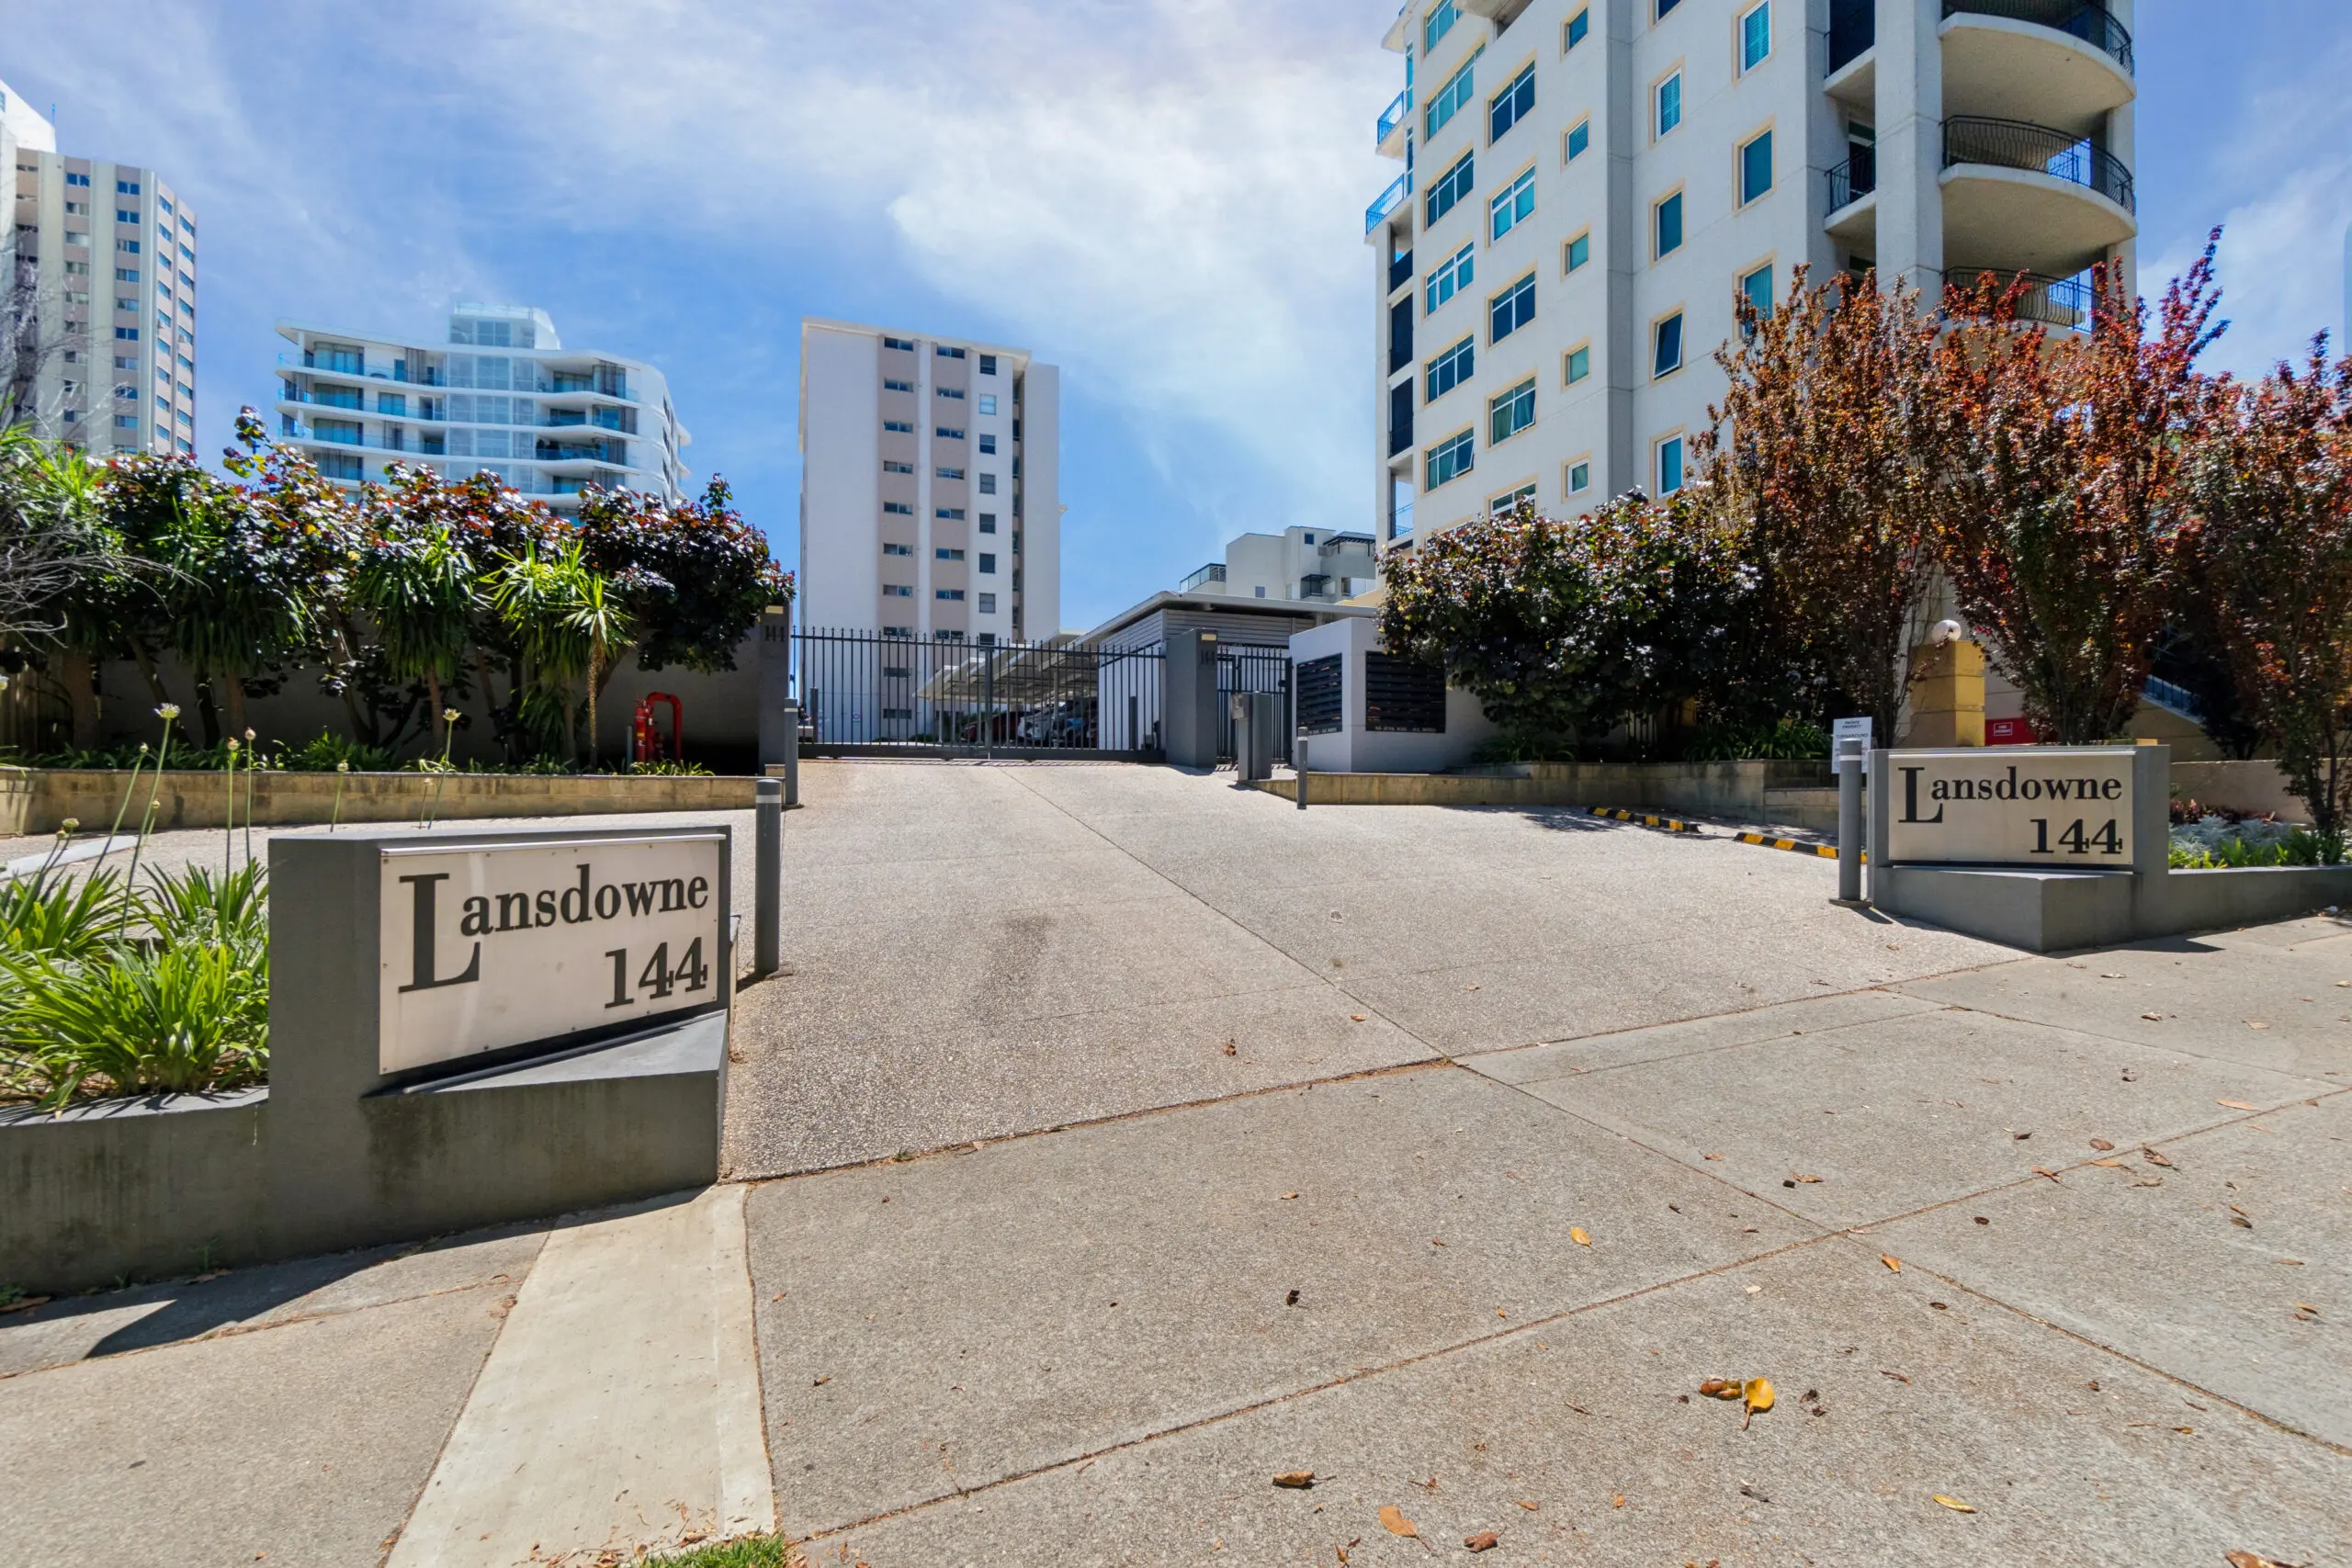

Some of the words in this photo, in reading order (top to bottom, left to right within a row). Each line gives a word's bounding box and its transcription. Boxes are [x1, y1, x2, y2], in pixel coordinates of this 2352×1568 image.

[1898, 766, 2122, 823] Lansdowne
[2030, 818, 2123, 854] 144
[399, 863, 708, 993] Lansdowne
[605, 937, 708, 1009] 144
